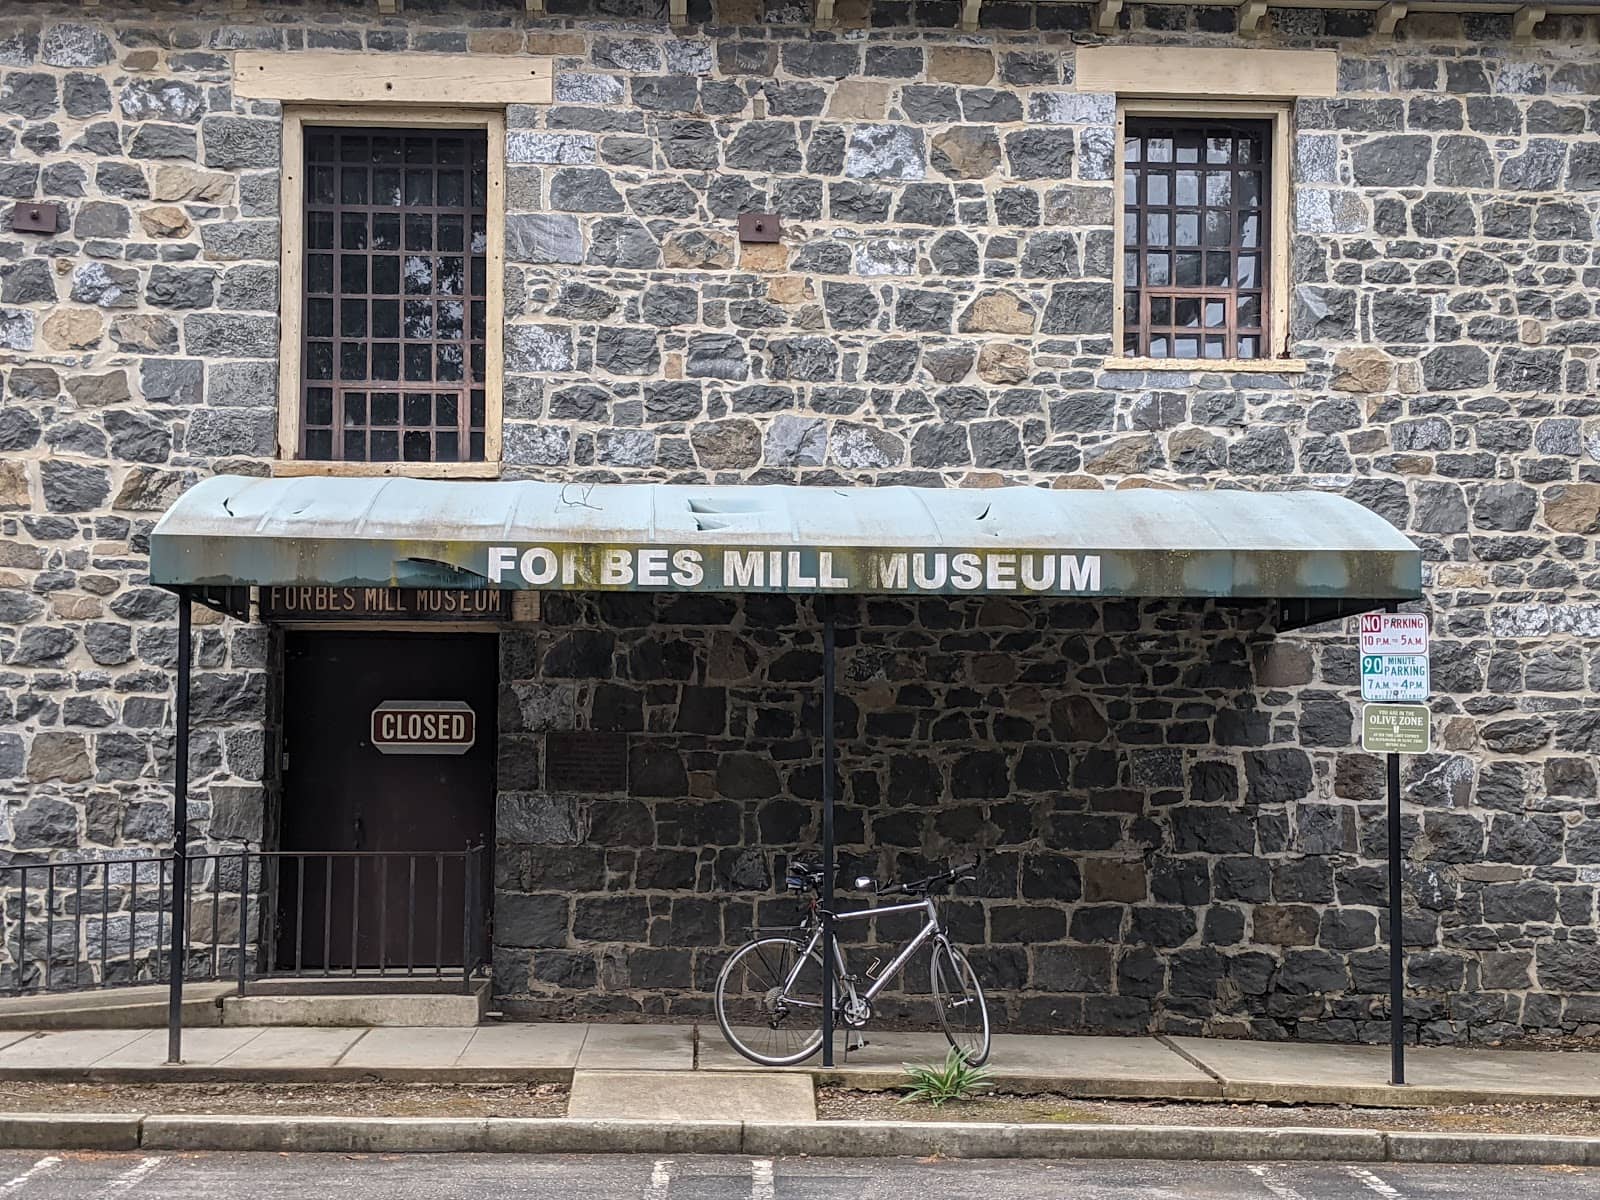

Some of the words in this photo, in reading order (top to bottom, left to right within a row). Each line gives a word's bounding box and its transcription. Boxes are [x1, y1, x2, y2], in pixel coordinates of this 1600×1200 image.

[723, 551, 848, 589] MILL
[877, 552, 1102, 592] MUSEUM
[271, 587, 356, 610] FORBES
[365, 588, 407, 611] MILL
[417, 588, 501, 612] MUSEUM
[1362, 616, 1380, 631] NO
[1384, 618, 1424, 629] PARKING
[1364, 635, 1374, 645] 10
[1364, 657, 1382, 673] 90
[1388, 657, 1416, 665] MINUTE
[1384, 666, 1425, 676] PARKING
[382, 714, 465, 740] CLOSED
[1369, 715, 1397, 725] OLIVE
[1398, 716, 1424, 726] ZONE
